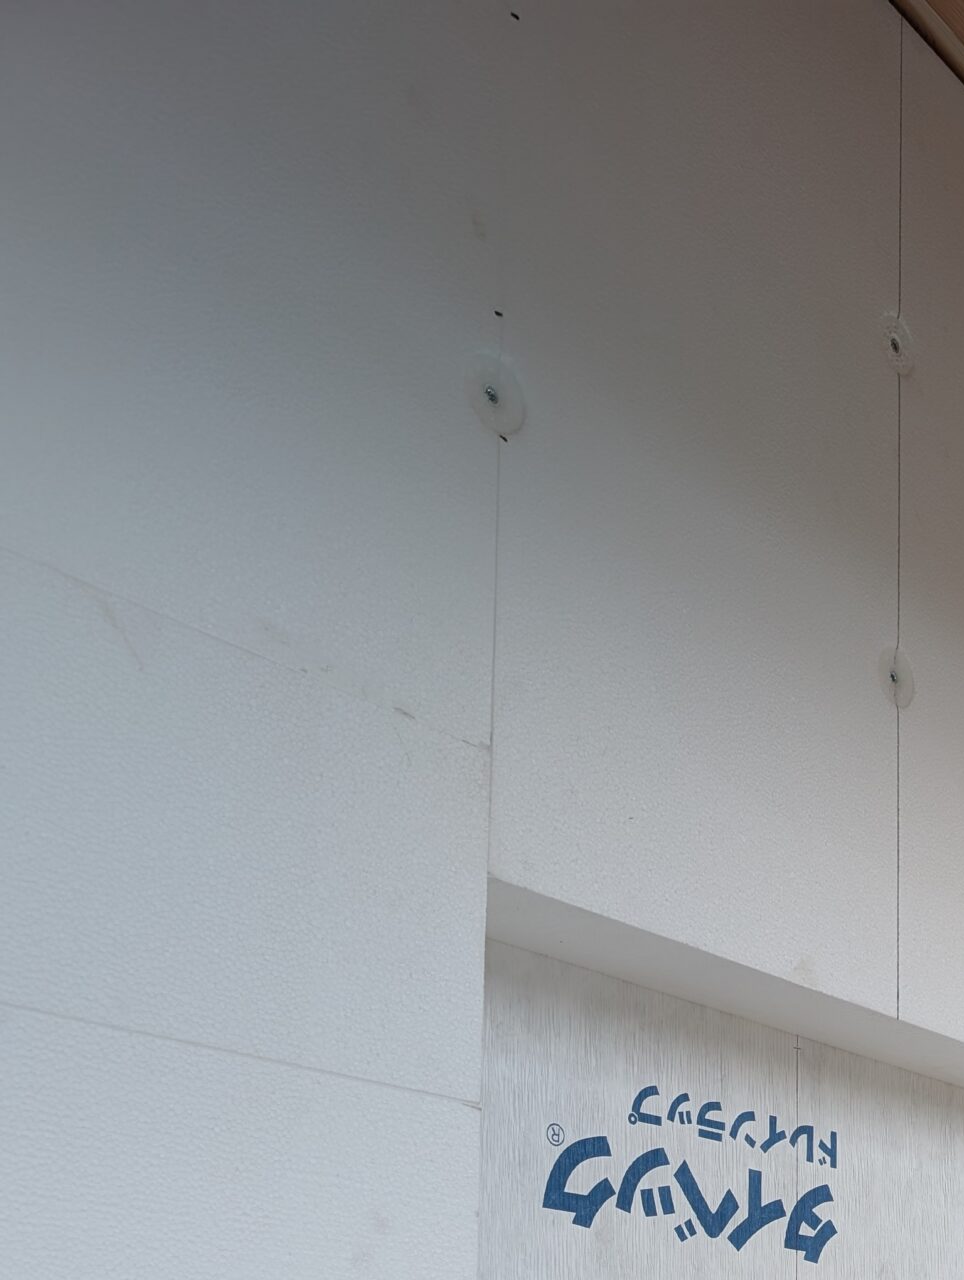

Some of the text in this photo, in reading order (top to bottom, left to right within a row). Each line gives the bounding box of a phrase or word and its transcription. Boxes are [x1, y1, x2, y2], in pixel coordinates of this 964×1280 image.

[628, 1085, 838, 1169] ドレインラップ
[542, 1135, 838, 1264] タイベック
